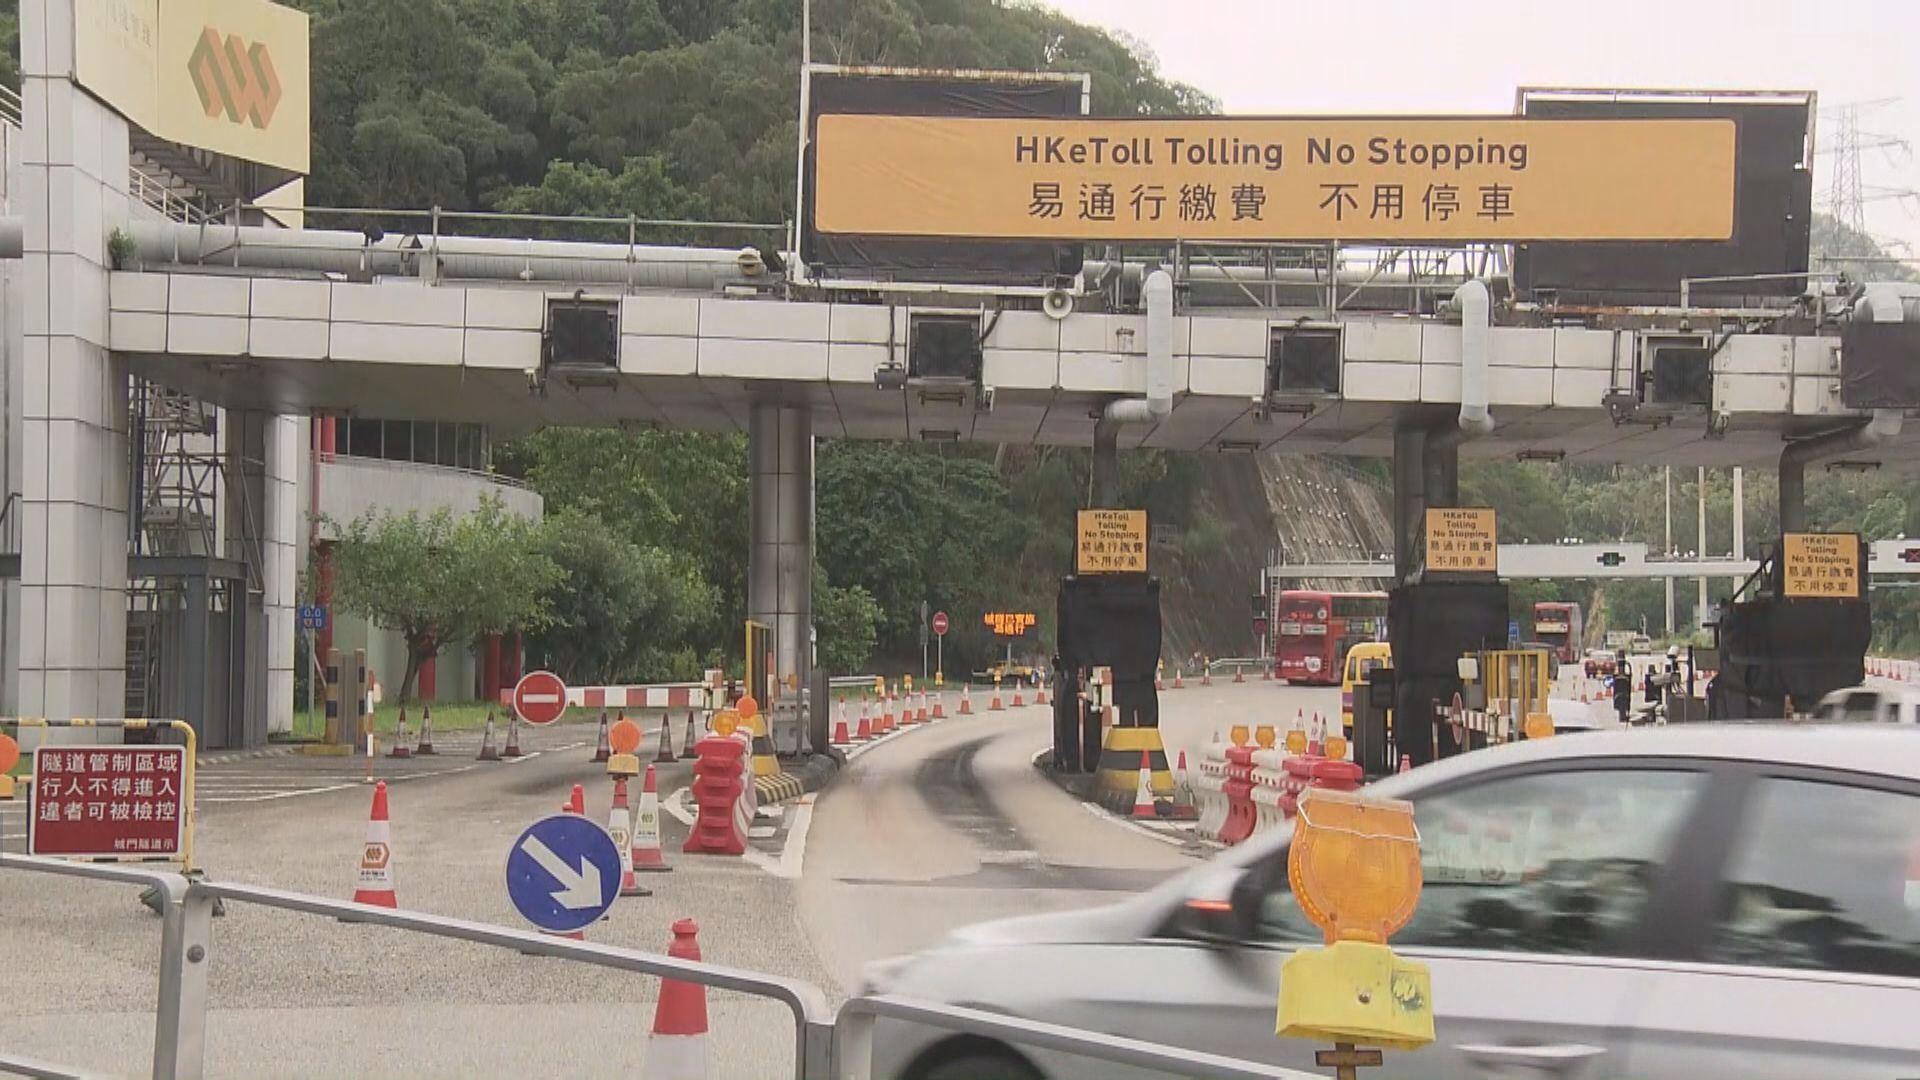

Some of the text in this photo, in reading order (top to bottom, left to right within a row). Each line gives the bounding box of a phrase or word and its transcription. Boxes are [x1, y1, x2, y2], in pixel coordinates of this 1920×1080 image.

[1017, 136, 1526, 170] HKeToll Tolling No Stopping
[1029, 183, 1514, 221] 易通行繳費 不用停車
[42, 753, 177, 772] 隧道管制區域
[41, 777, 176, 796] 行人不得進入
[40, 801, 175, 821] 違者可被檢控
